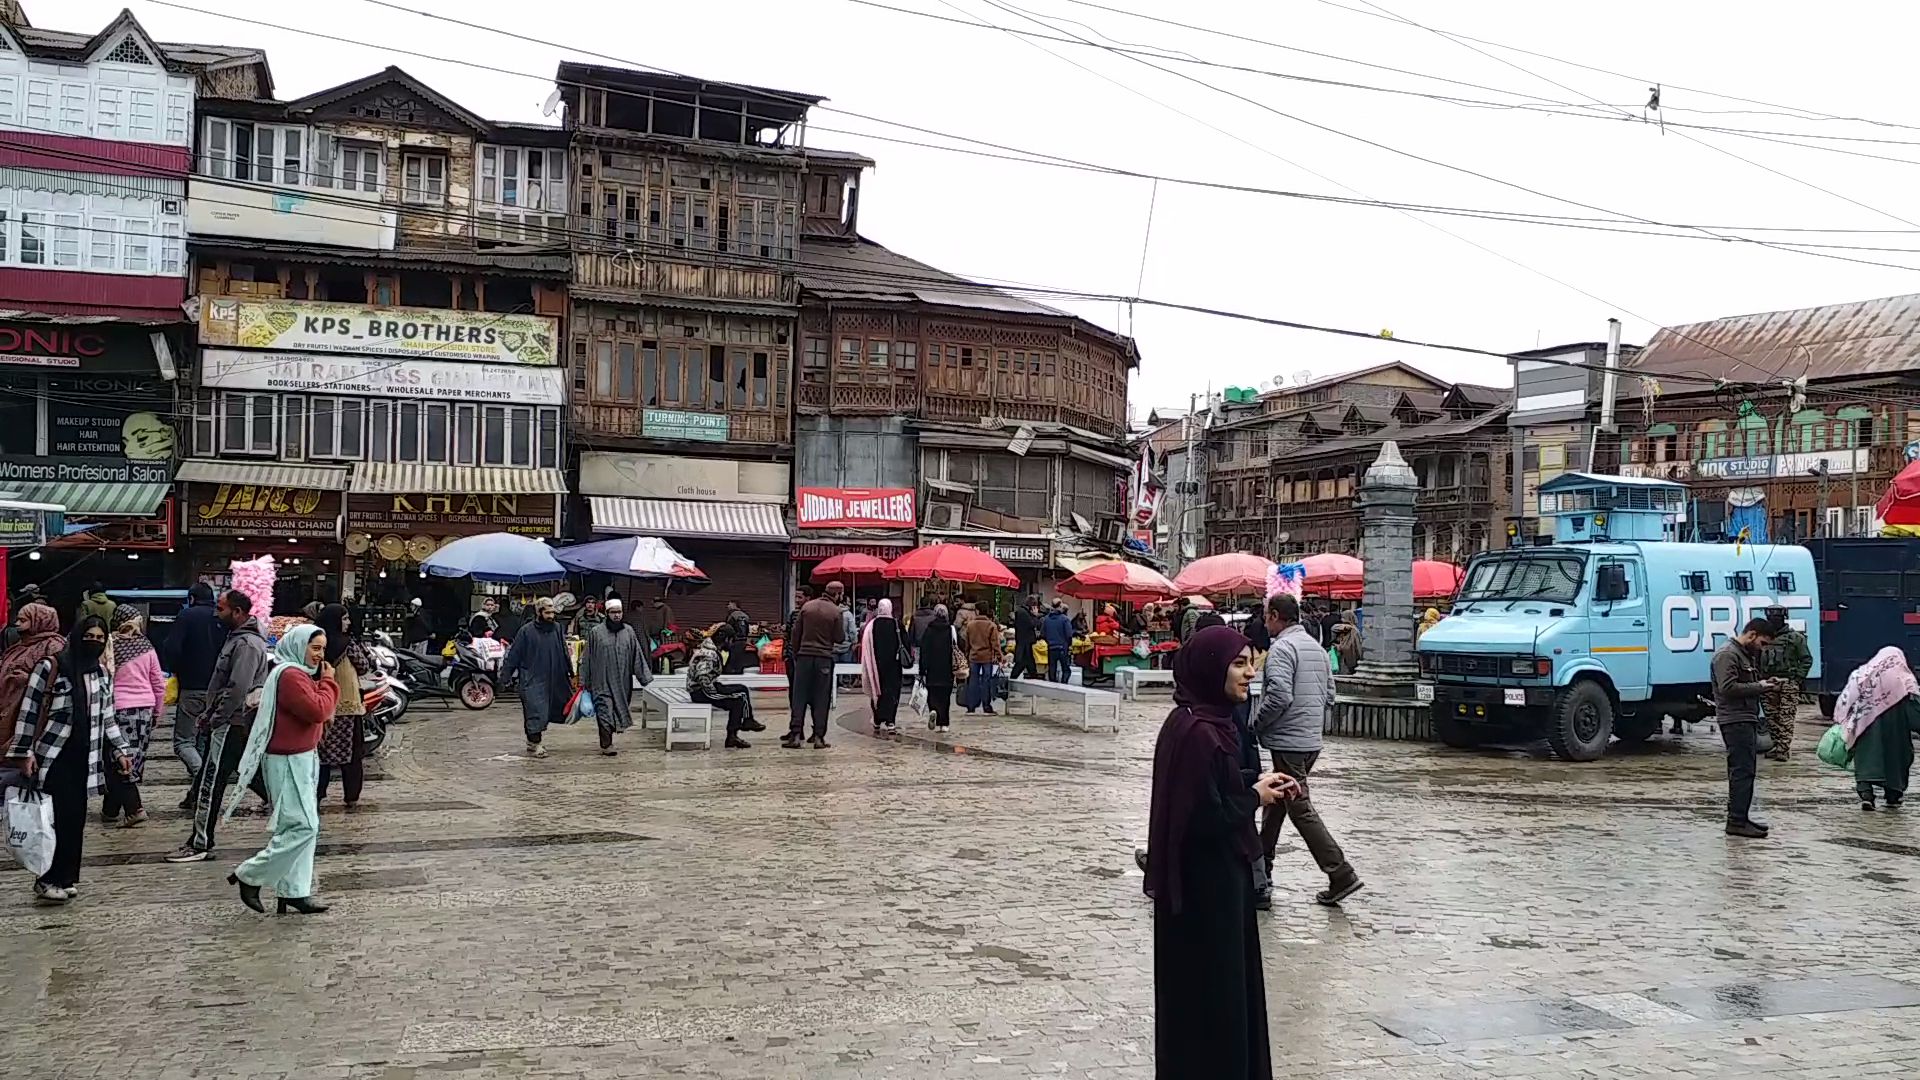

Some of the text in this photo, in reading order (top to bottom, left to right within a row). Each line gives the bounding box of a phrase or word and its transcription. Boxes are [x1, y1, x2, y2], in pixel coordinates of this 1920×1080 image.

[210, 302, 238, 321] KPS
[386, 385, 434, 396] WHOLESALE
[437, 388, 462, 397] PAPER
[465, 391, 511, 399] MERCHANTS
[57, 417, 120, 427] MAKEUP STUDIO
[649, 412, 722, 427] TURNING POINT
[79, 431, 98, 439] HAIR
[57, 443, 76, 451] HAIR
[0, 461, 166, 482] Womens Profesional Salon
[1730, 459, 1768, 471] STUDIO
[677, 485, 716, 496] Cloth house
[391, 494, 518, 515] KHAN
[800, 492, 912, 522] JIDDAH JEWELLERS
[198, 518, 334, 529] JAI RAM DASS GIAN CHAND
[792, 544, 835, 558] JIDDAH
[985, 540, 1044, 560] JEWELLERS
[10, 826, 28, 843] Jeep
